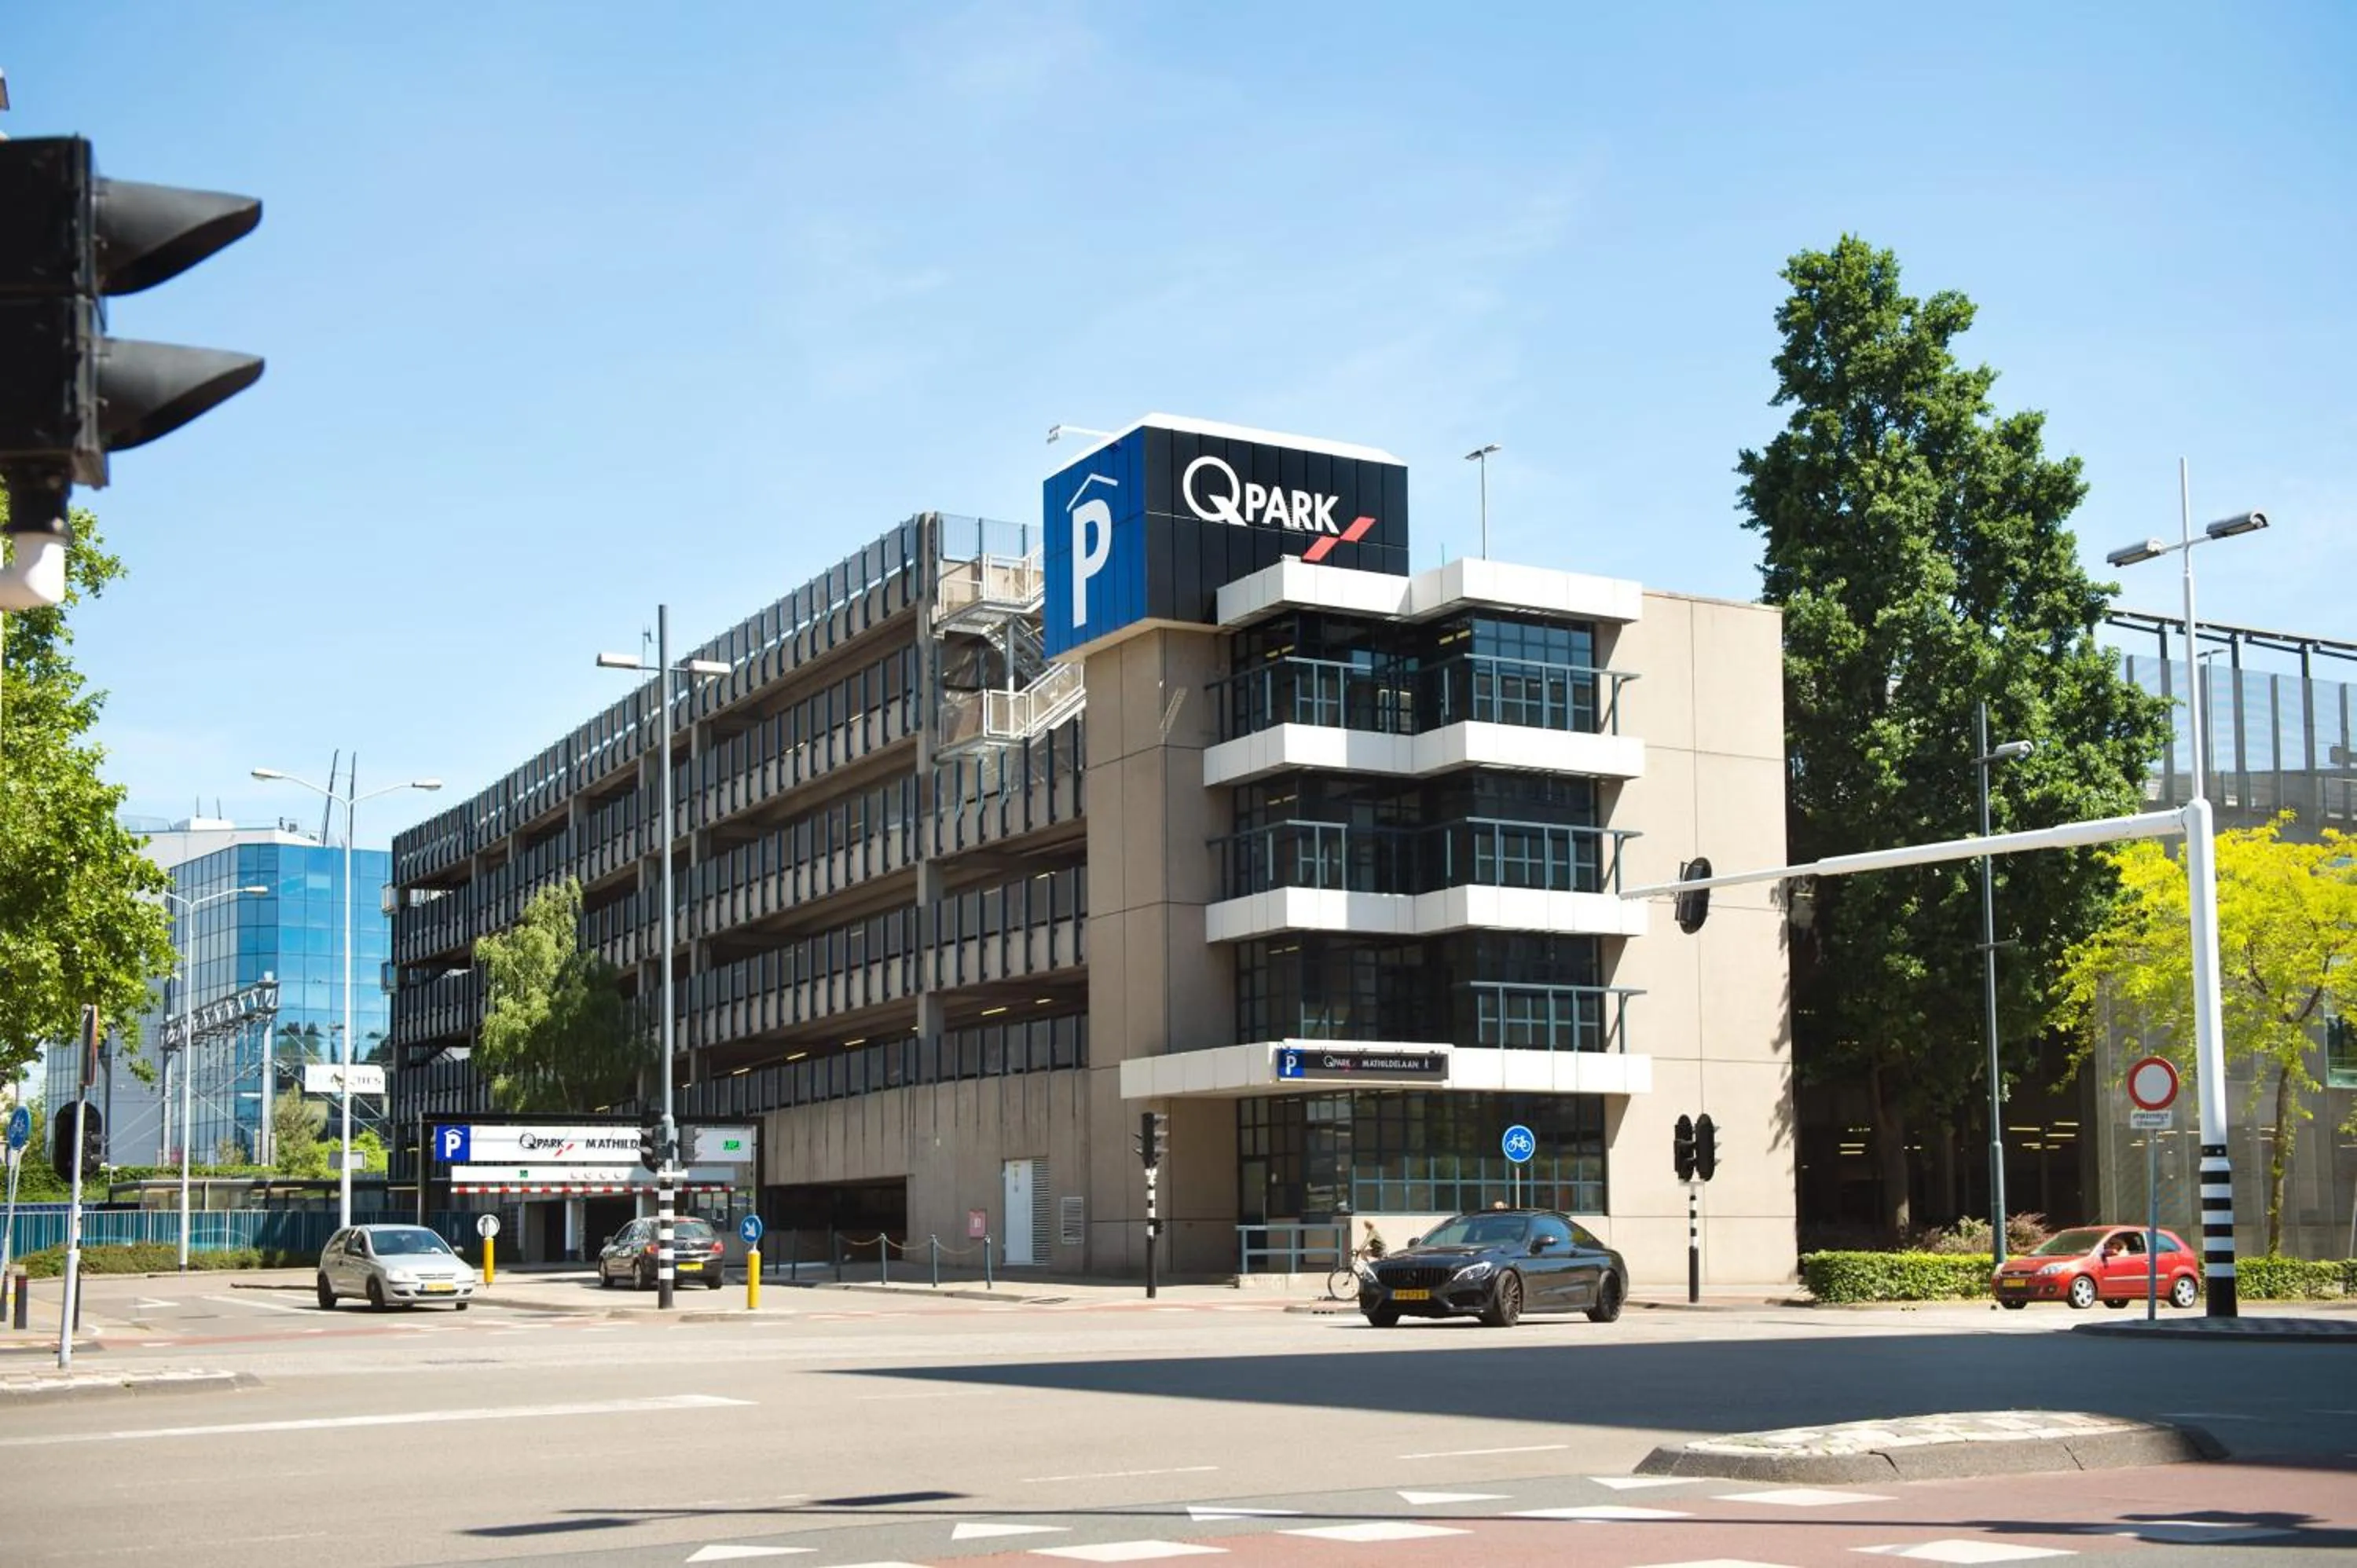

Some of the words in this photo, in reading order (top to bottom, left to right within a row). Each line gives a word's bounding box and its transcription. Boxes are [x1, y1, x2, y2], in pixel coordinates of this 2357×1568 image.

[1182, 456, 1340, 535] QPARK
[1072, 499, 1113, 628] P
[1286, 1053, 1297, 1075] P
[445, 1134, 460, 1157] P
[585, 1138, 640, 1149] MATHILD
